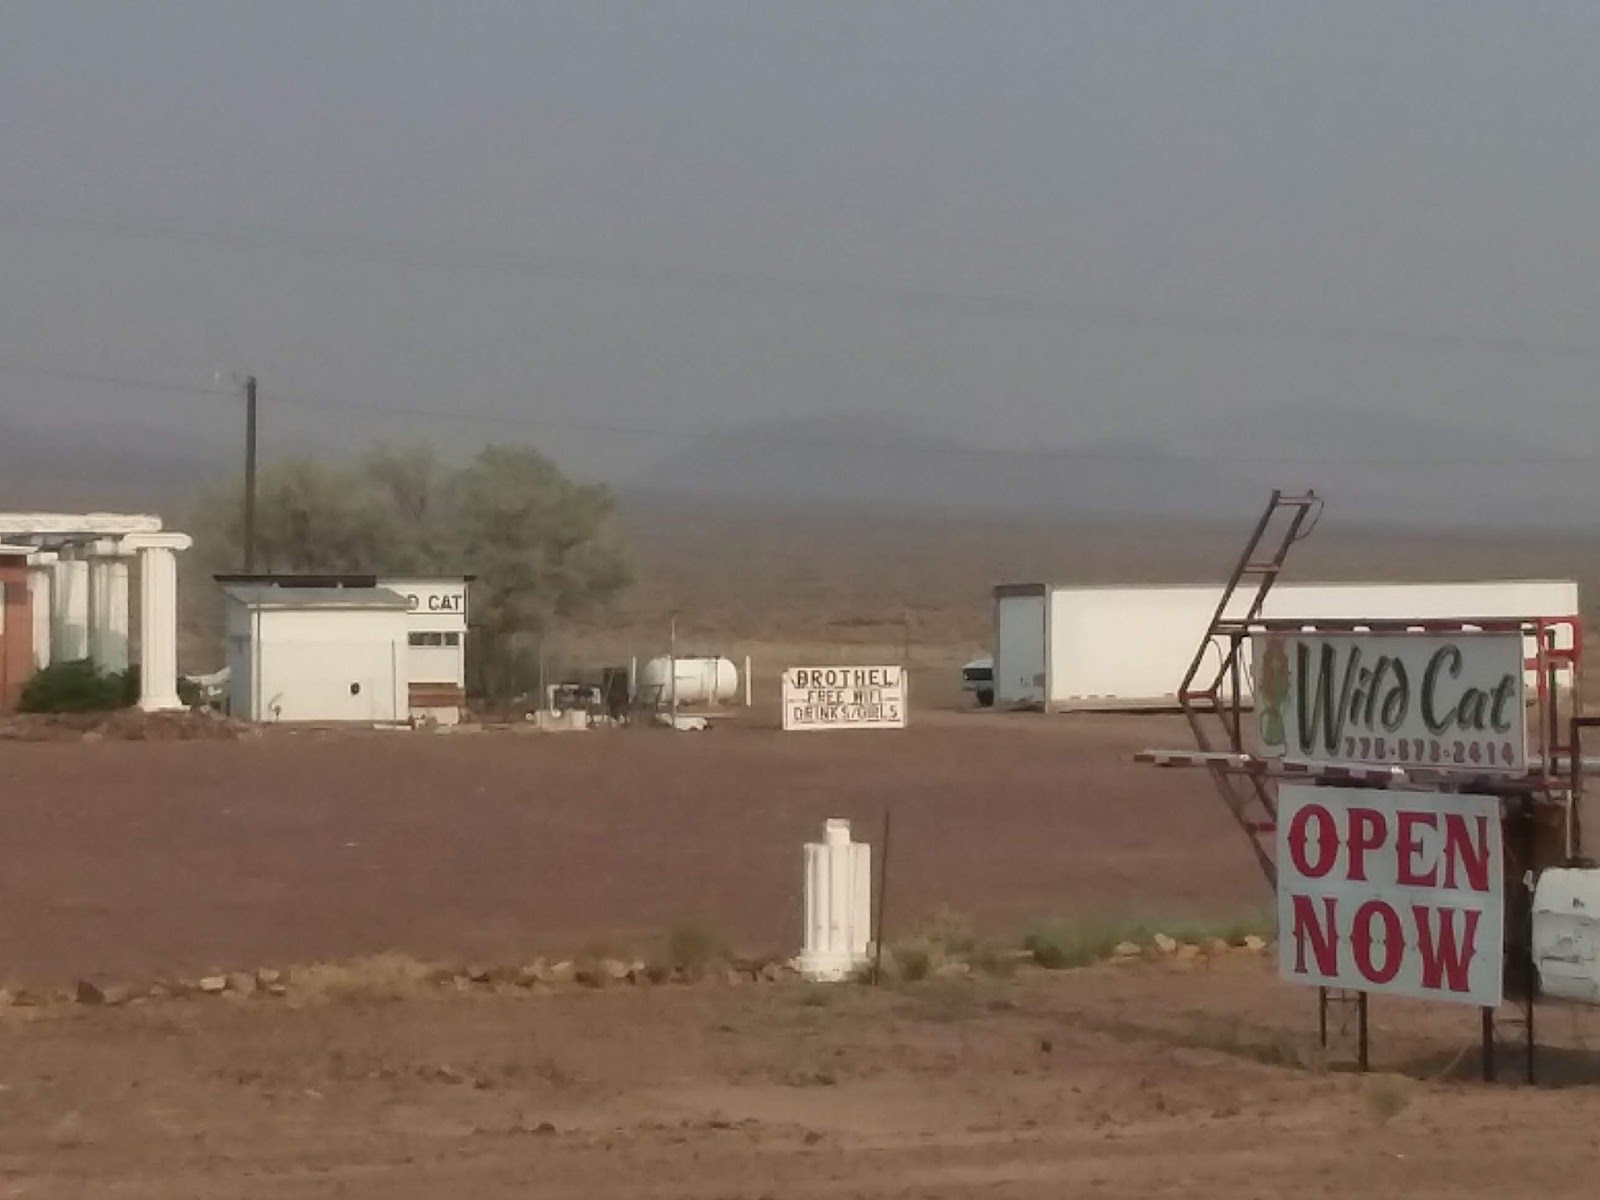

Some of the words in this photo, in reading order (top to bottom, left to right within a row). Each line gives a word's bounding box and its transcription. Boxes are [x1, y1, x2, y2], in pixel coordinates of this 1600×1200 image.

[428, 594, 462, 610] CAT
[797, 669, 893, 687] BROTHEL
[1297, 641, 1410, 756] Wild
[1420, 643, 1515, 737] Cat
[1288, 804, 1490, 893] OPEN
[1291, 894, 1482, 993] NOW
